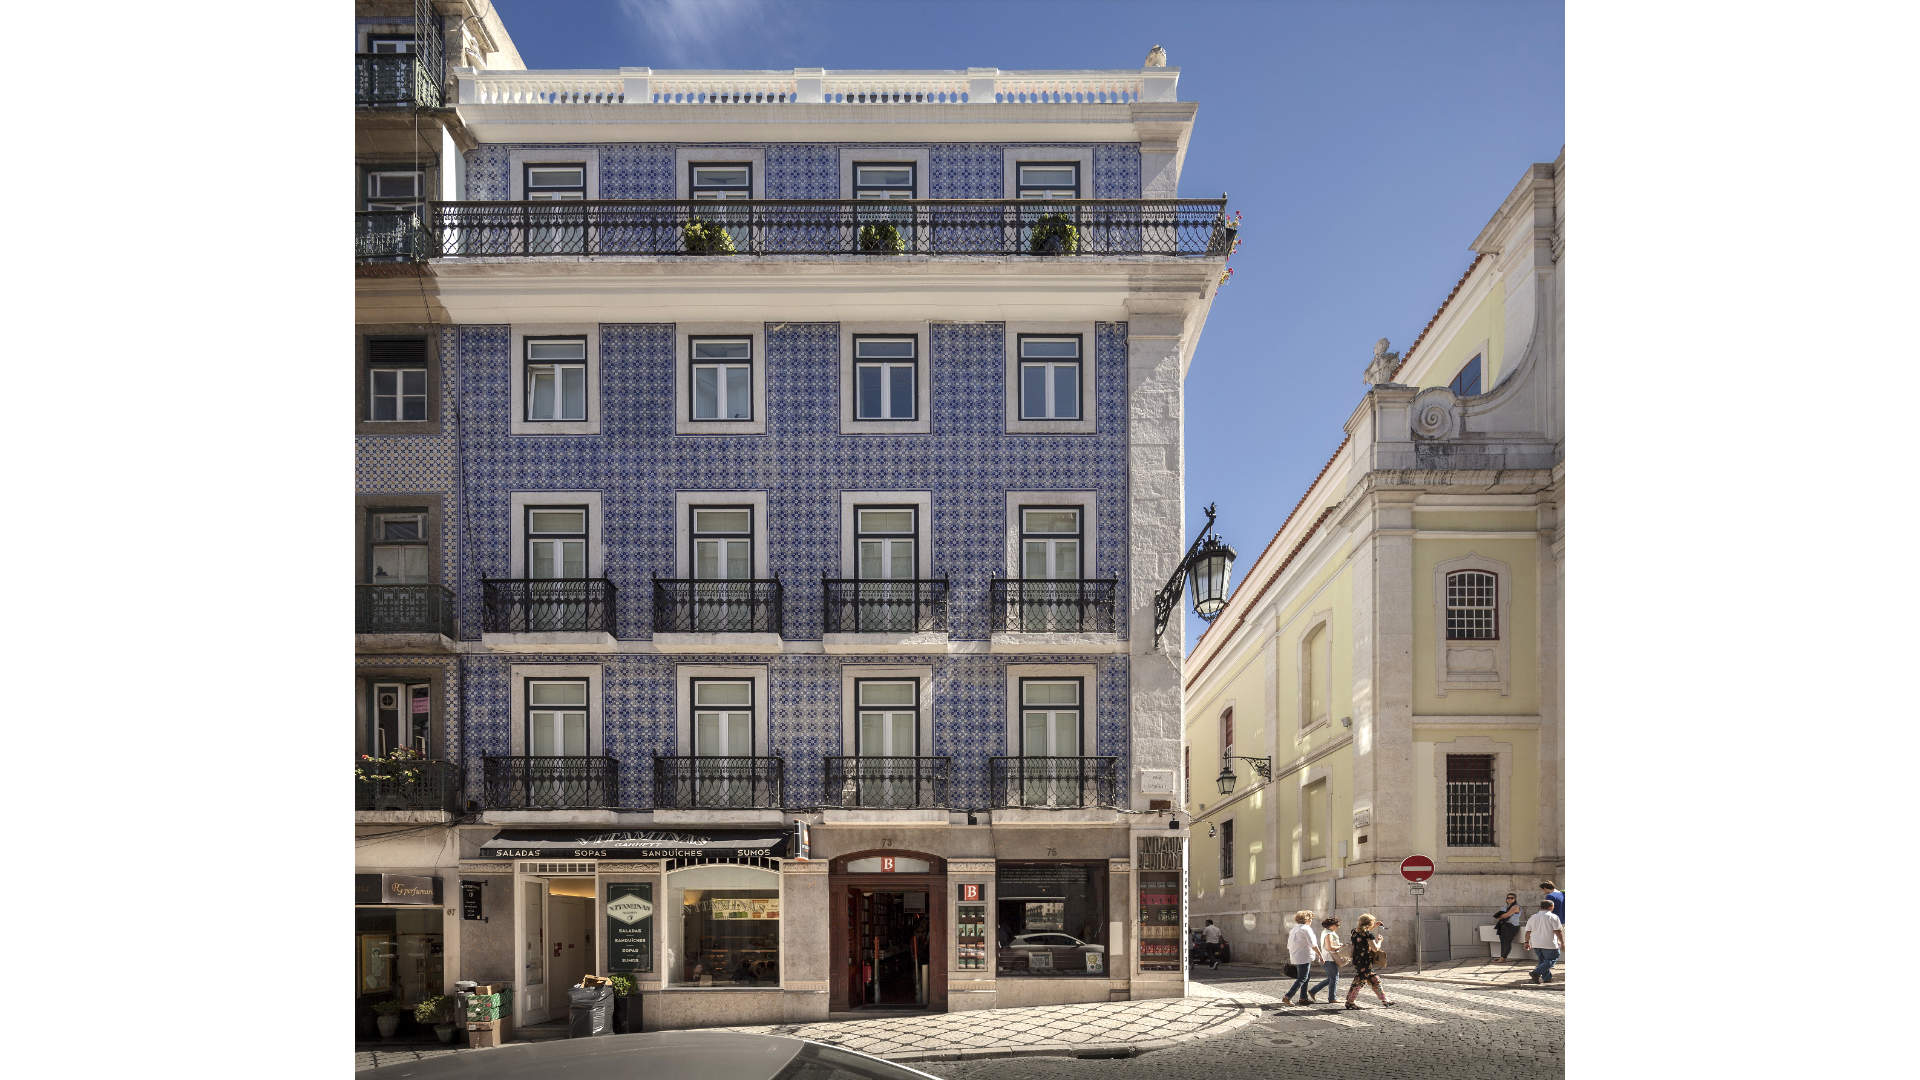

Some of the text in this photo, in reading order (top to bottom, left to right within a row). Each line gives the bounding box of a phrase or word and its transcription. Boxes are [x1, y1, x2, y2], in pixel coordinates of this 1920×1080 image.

[496, 849, 541, 857] SALADAS
[574, 849, 607, 857] SOPAS
[642, 848, 703, 857] SANDUÍCHES
[884, 857, 894, 870] B
[967, 885, 977, 898] B
